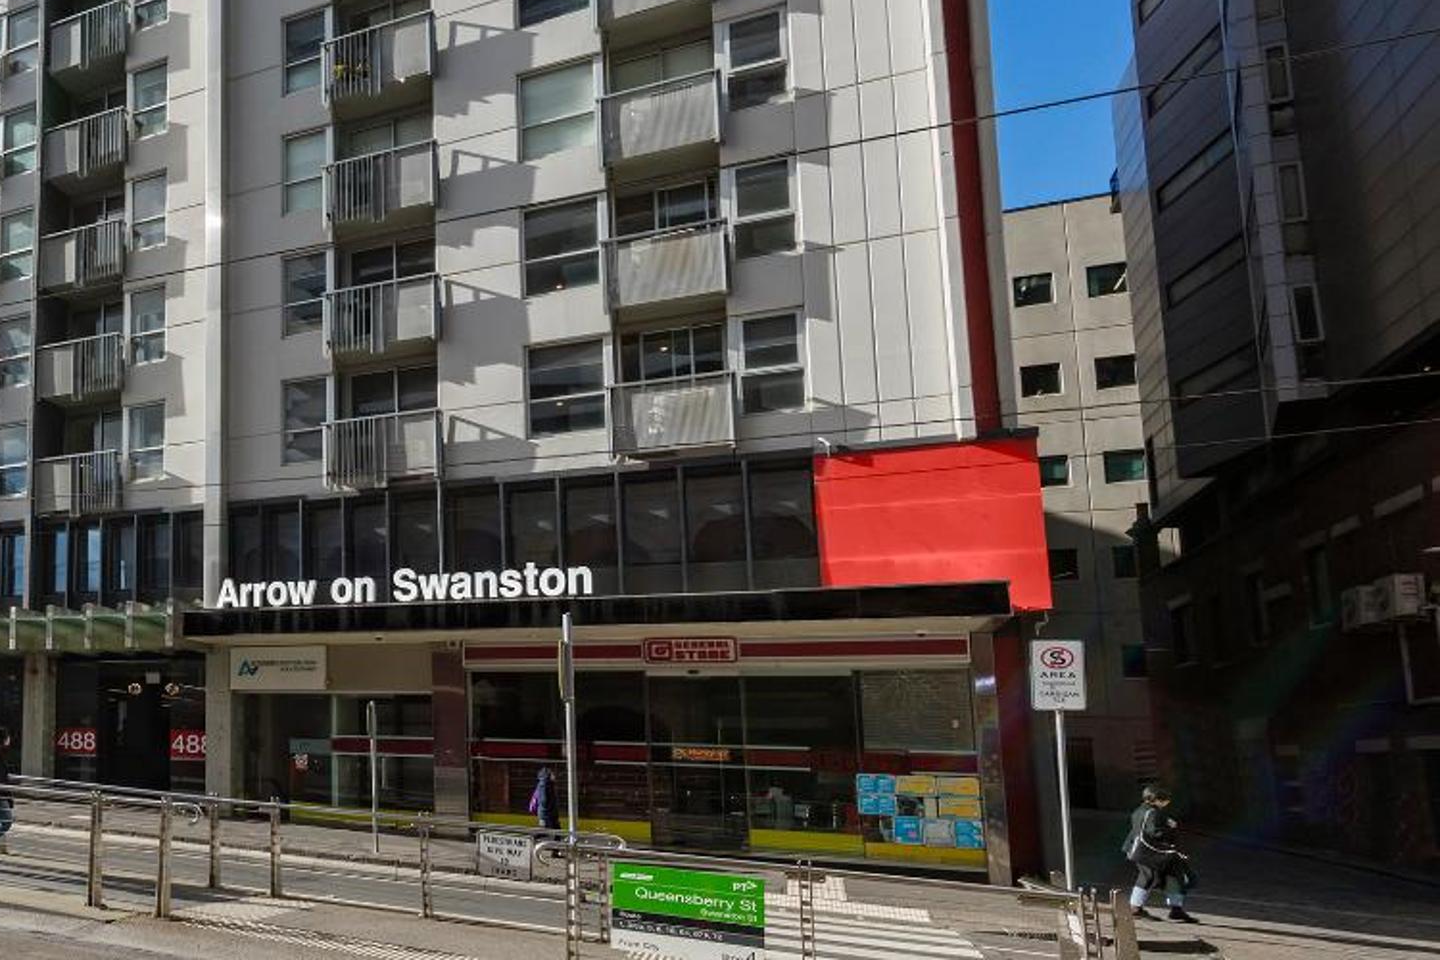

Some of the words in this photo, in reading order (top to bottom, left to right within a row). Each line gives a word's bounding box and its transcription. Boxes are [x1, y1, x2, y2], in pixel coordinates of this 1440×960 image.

[215, 577, 317, 608] Arrow
[331, 575, 376, 604] on
[392, 561, 594, 603] Swanston
[673, 640, 730, 649] GENERAL
[673, 650, 731, 660] STORE
[57, 732, 96, 751] 488
[634, 886, 735, 910] Queensberry
[739, 899, 758, 913] St
